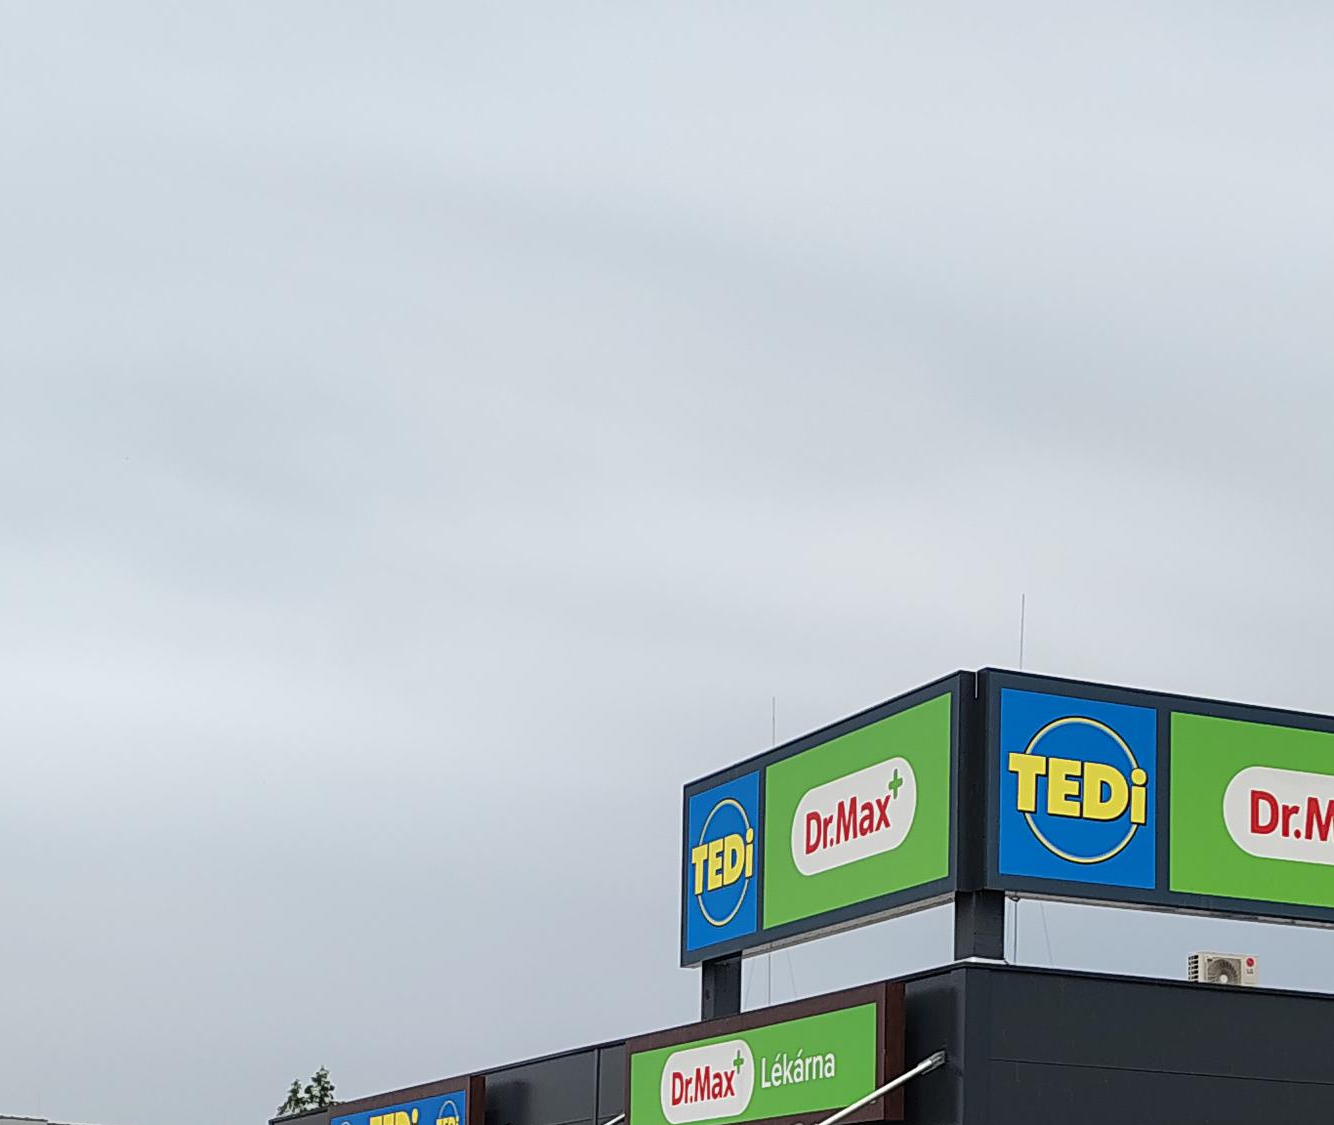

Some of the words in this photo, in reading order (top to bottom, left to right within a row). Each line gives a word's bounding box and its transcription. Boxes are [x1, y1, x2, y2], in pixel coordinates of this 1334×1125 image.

[1008, 752, 1148, 825] TEDi
[691, 828, 754, 895] TEDi
[761, 1049, 835, 1089] Lékárna
